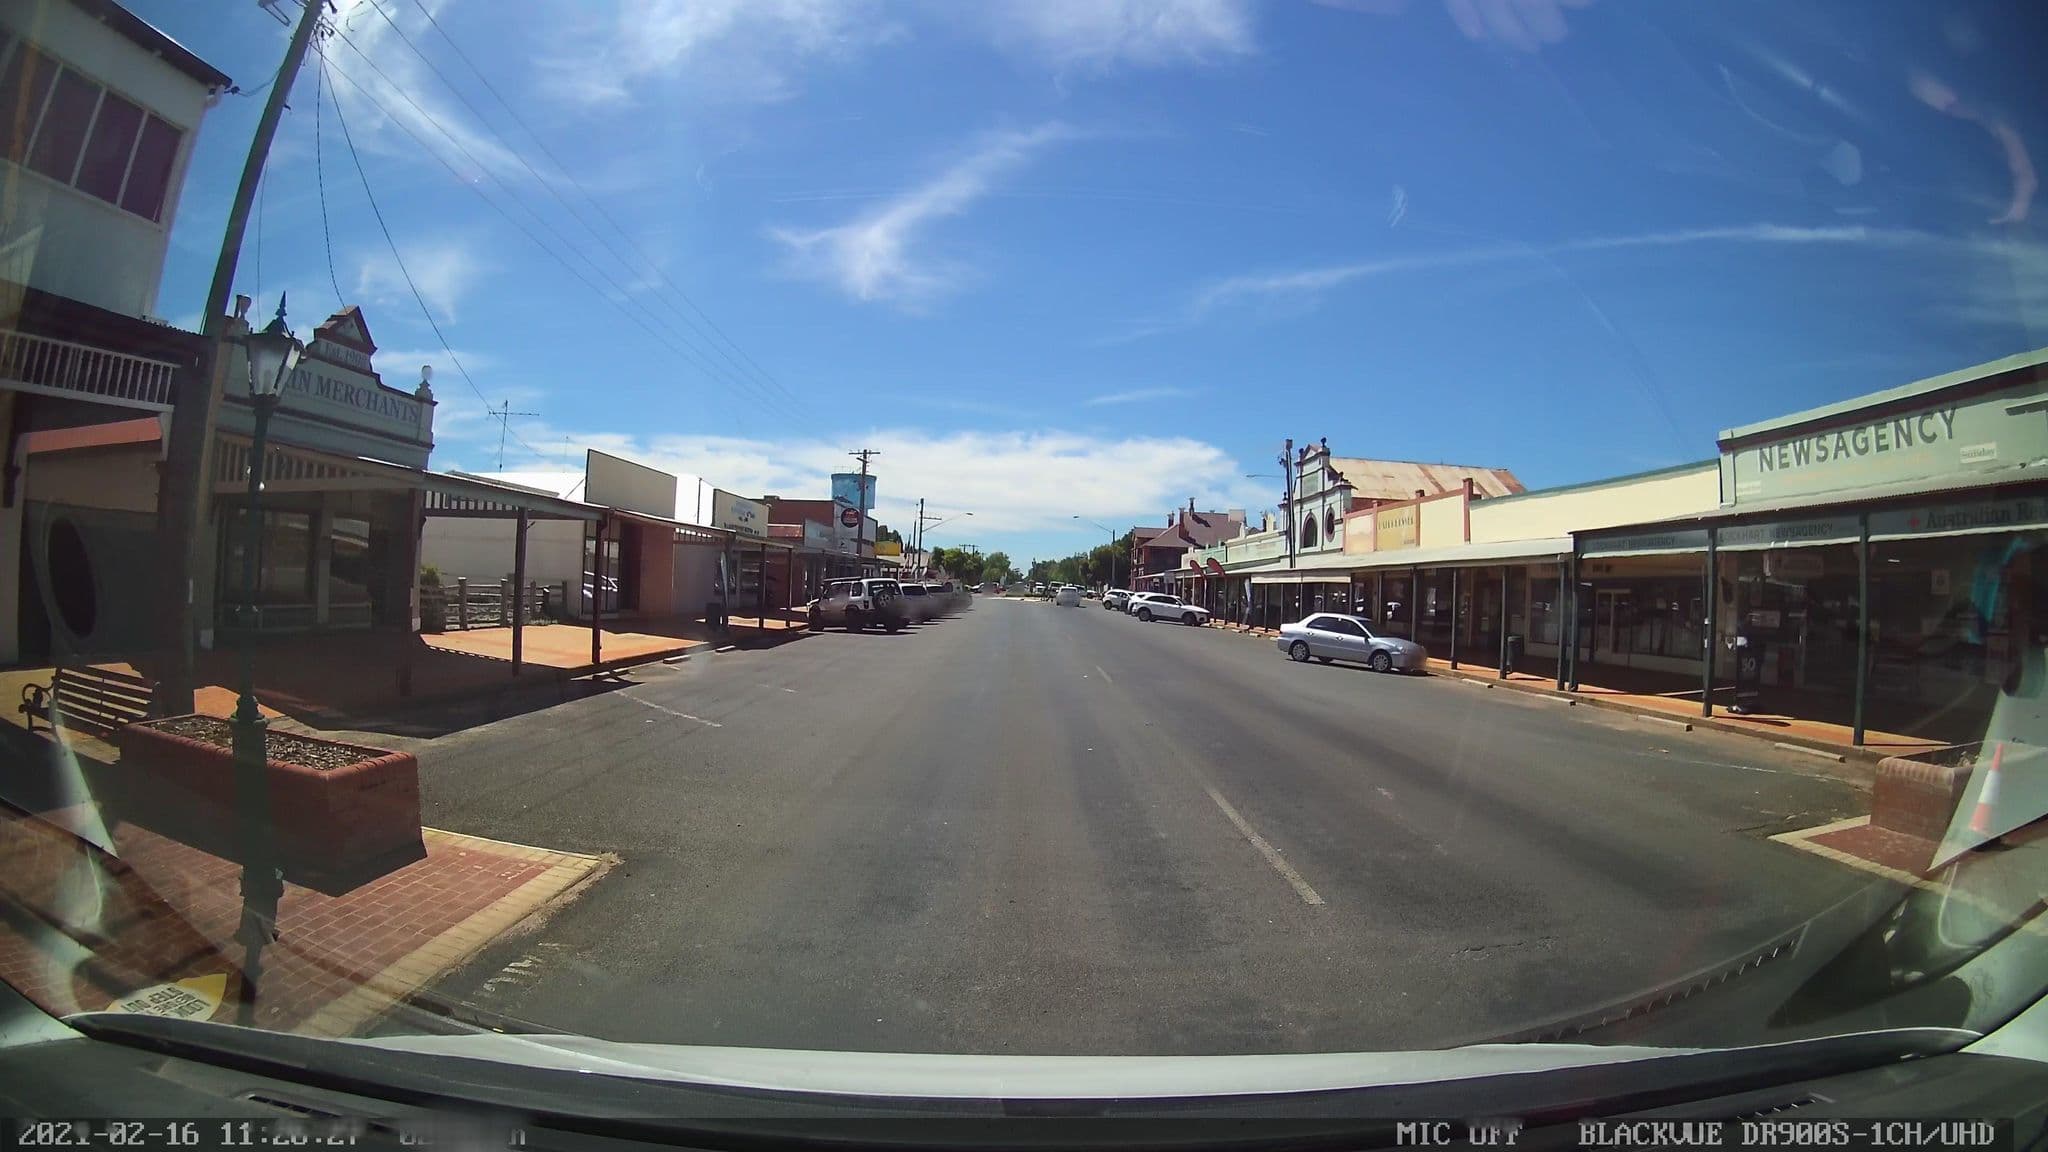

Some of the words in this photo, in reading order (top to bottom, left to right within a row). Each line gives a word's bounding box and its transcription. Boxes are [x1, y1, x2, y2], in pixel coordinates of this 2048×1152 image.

[315, 375, 419, 423] MERCHANTS
[1758, 406, 1956, 473] NEWSAGENCY
[1926, 505, 2010, 529] Australian
